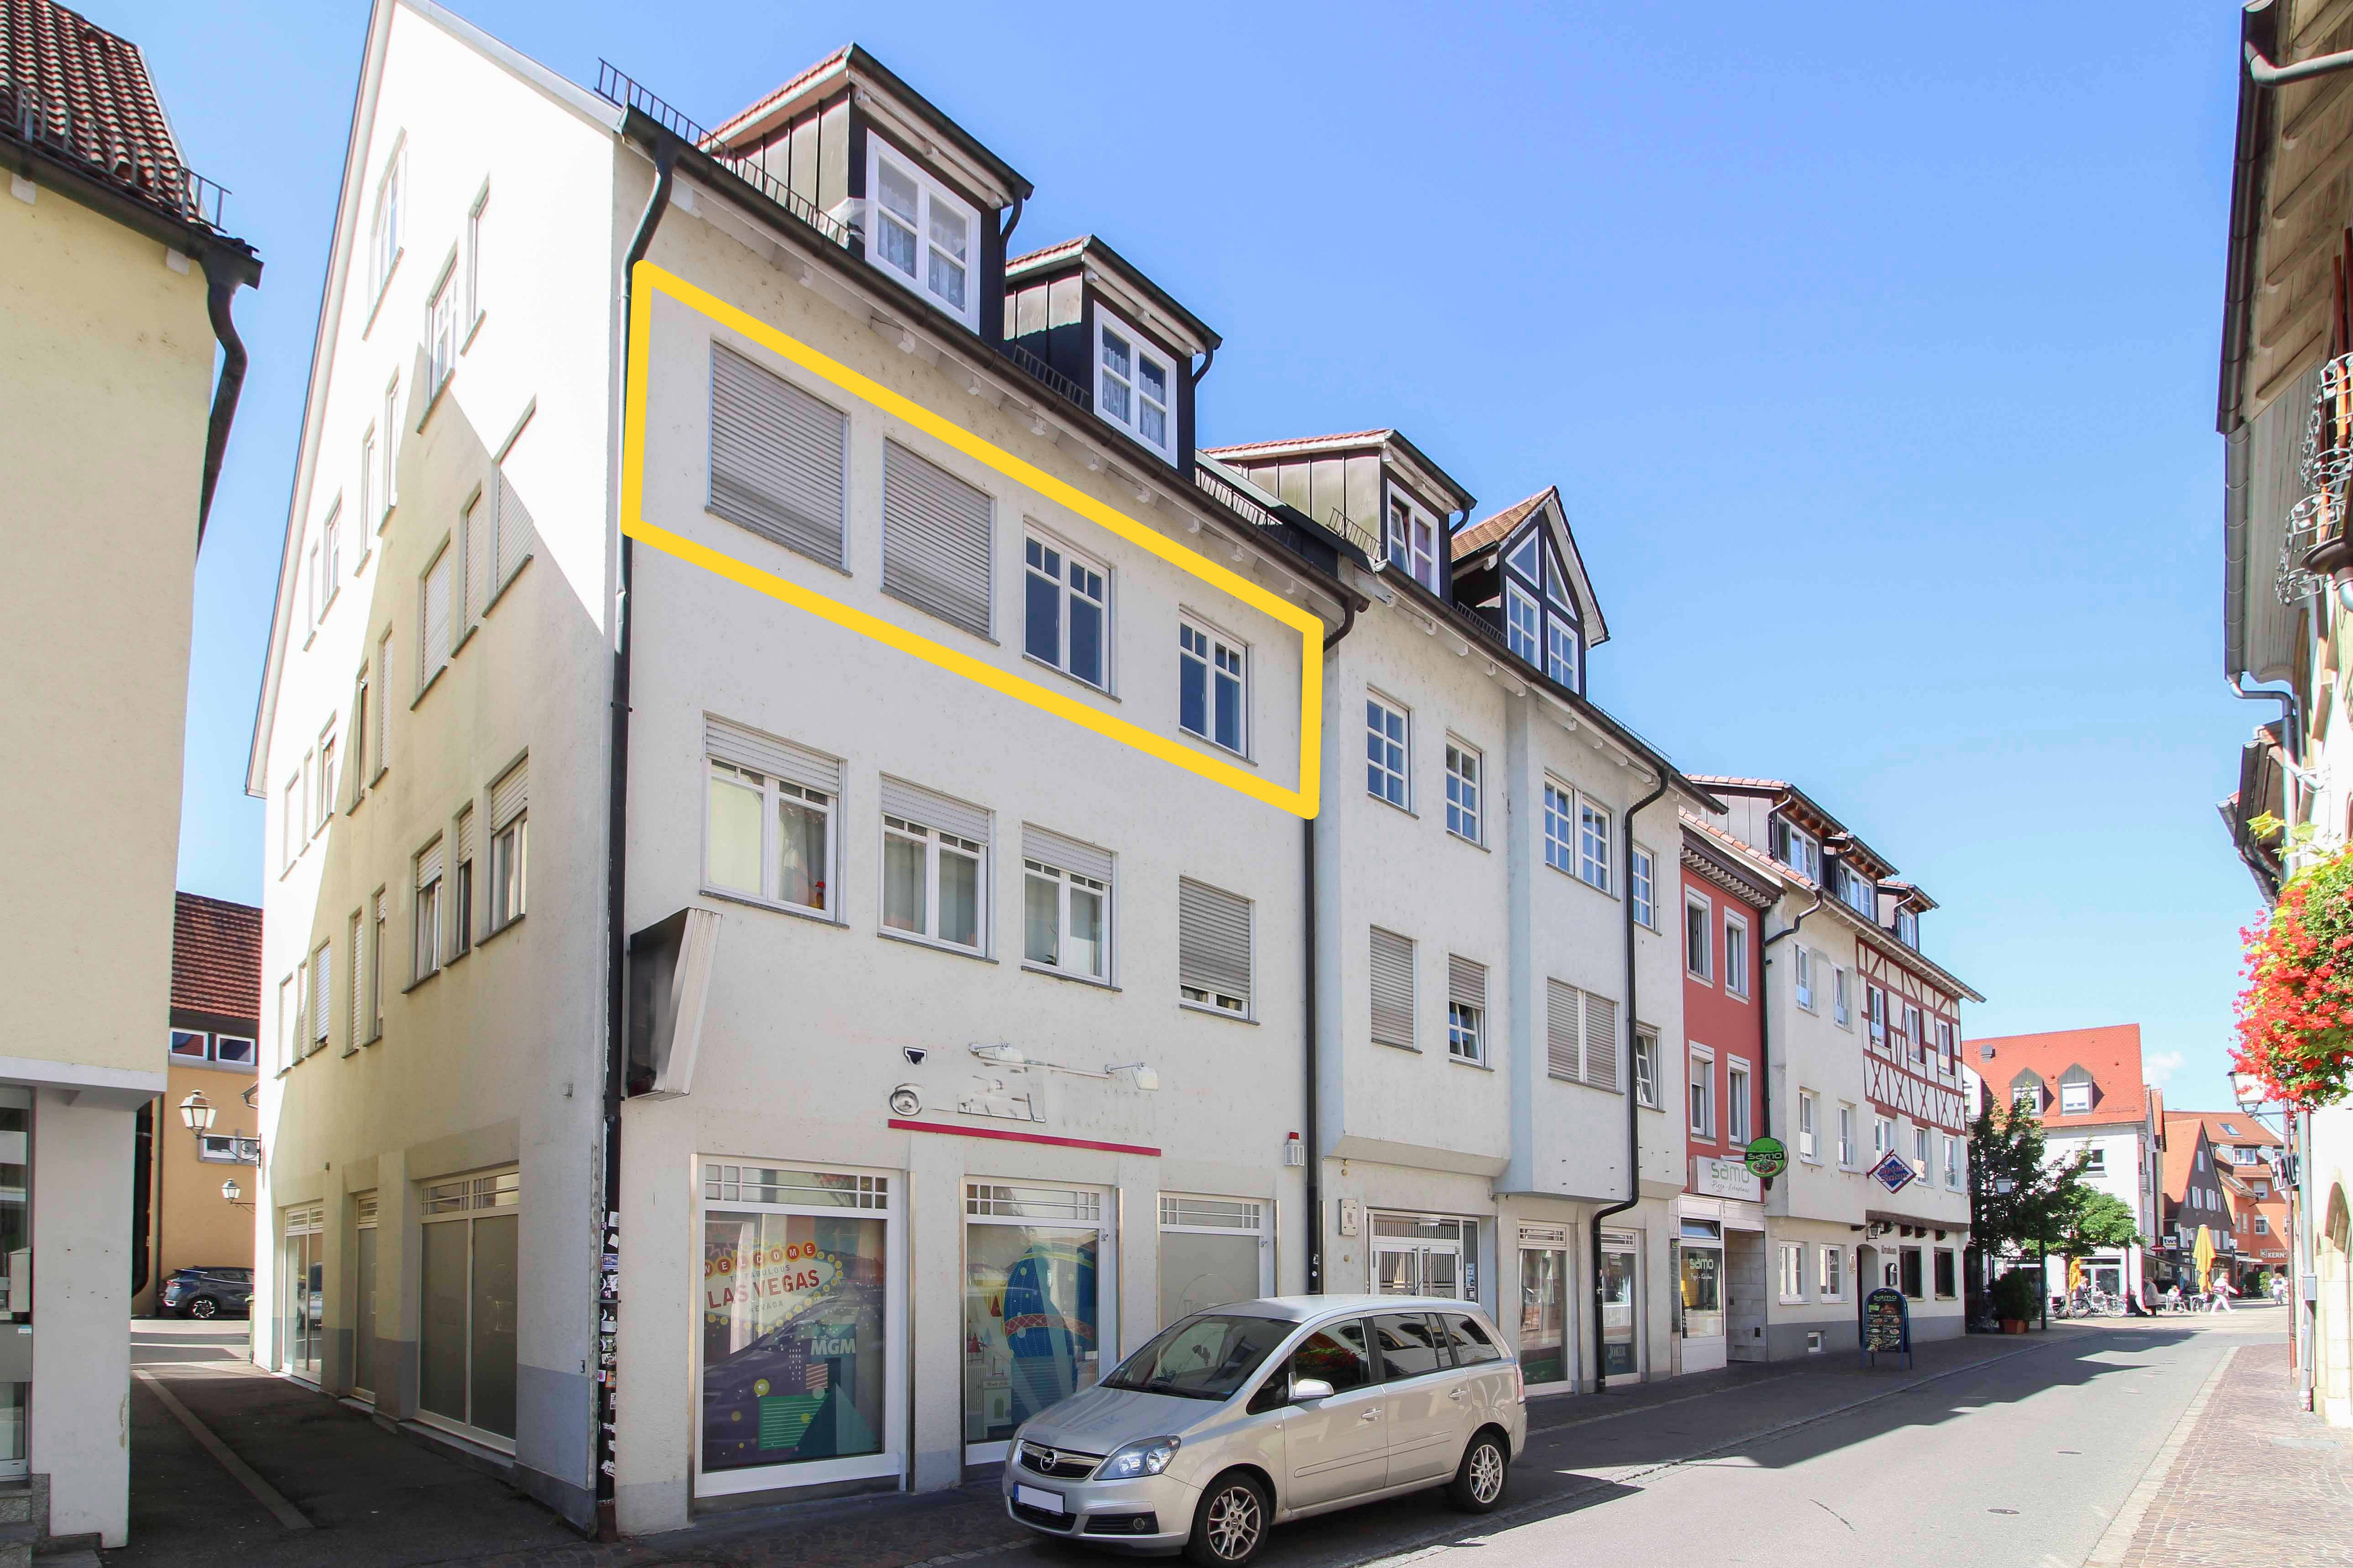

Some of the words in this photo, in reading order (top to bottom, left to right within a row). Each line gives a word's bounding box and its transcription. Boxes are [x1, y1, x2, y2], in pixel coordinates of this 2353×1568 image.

[729, 1275, 740, 1283] TO
[745, 1264, 790, 1280] FABULOUS
[707, 1284, 749, 1309] LAS
[753, 1269, 820, 1298] VEGAS
[749, 1300, 784, 1314] NEVADA
[810, 1338, 857, 1355] MGM
